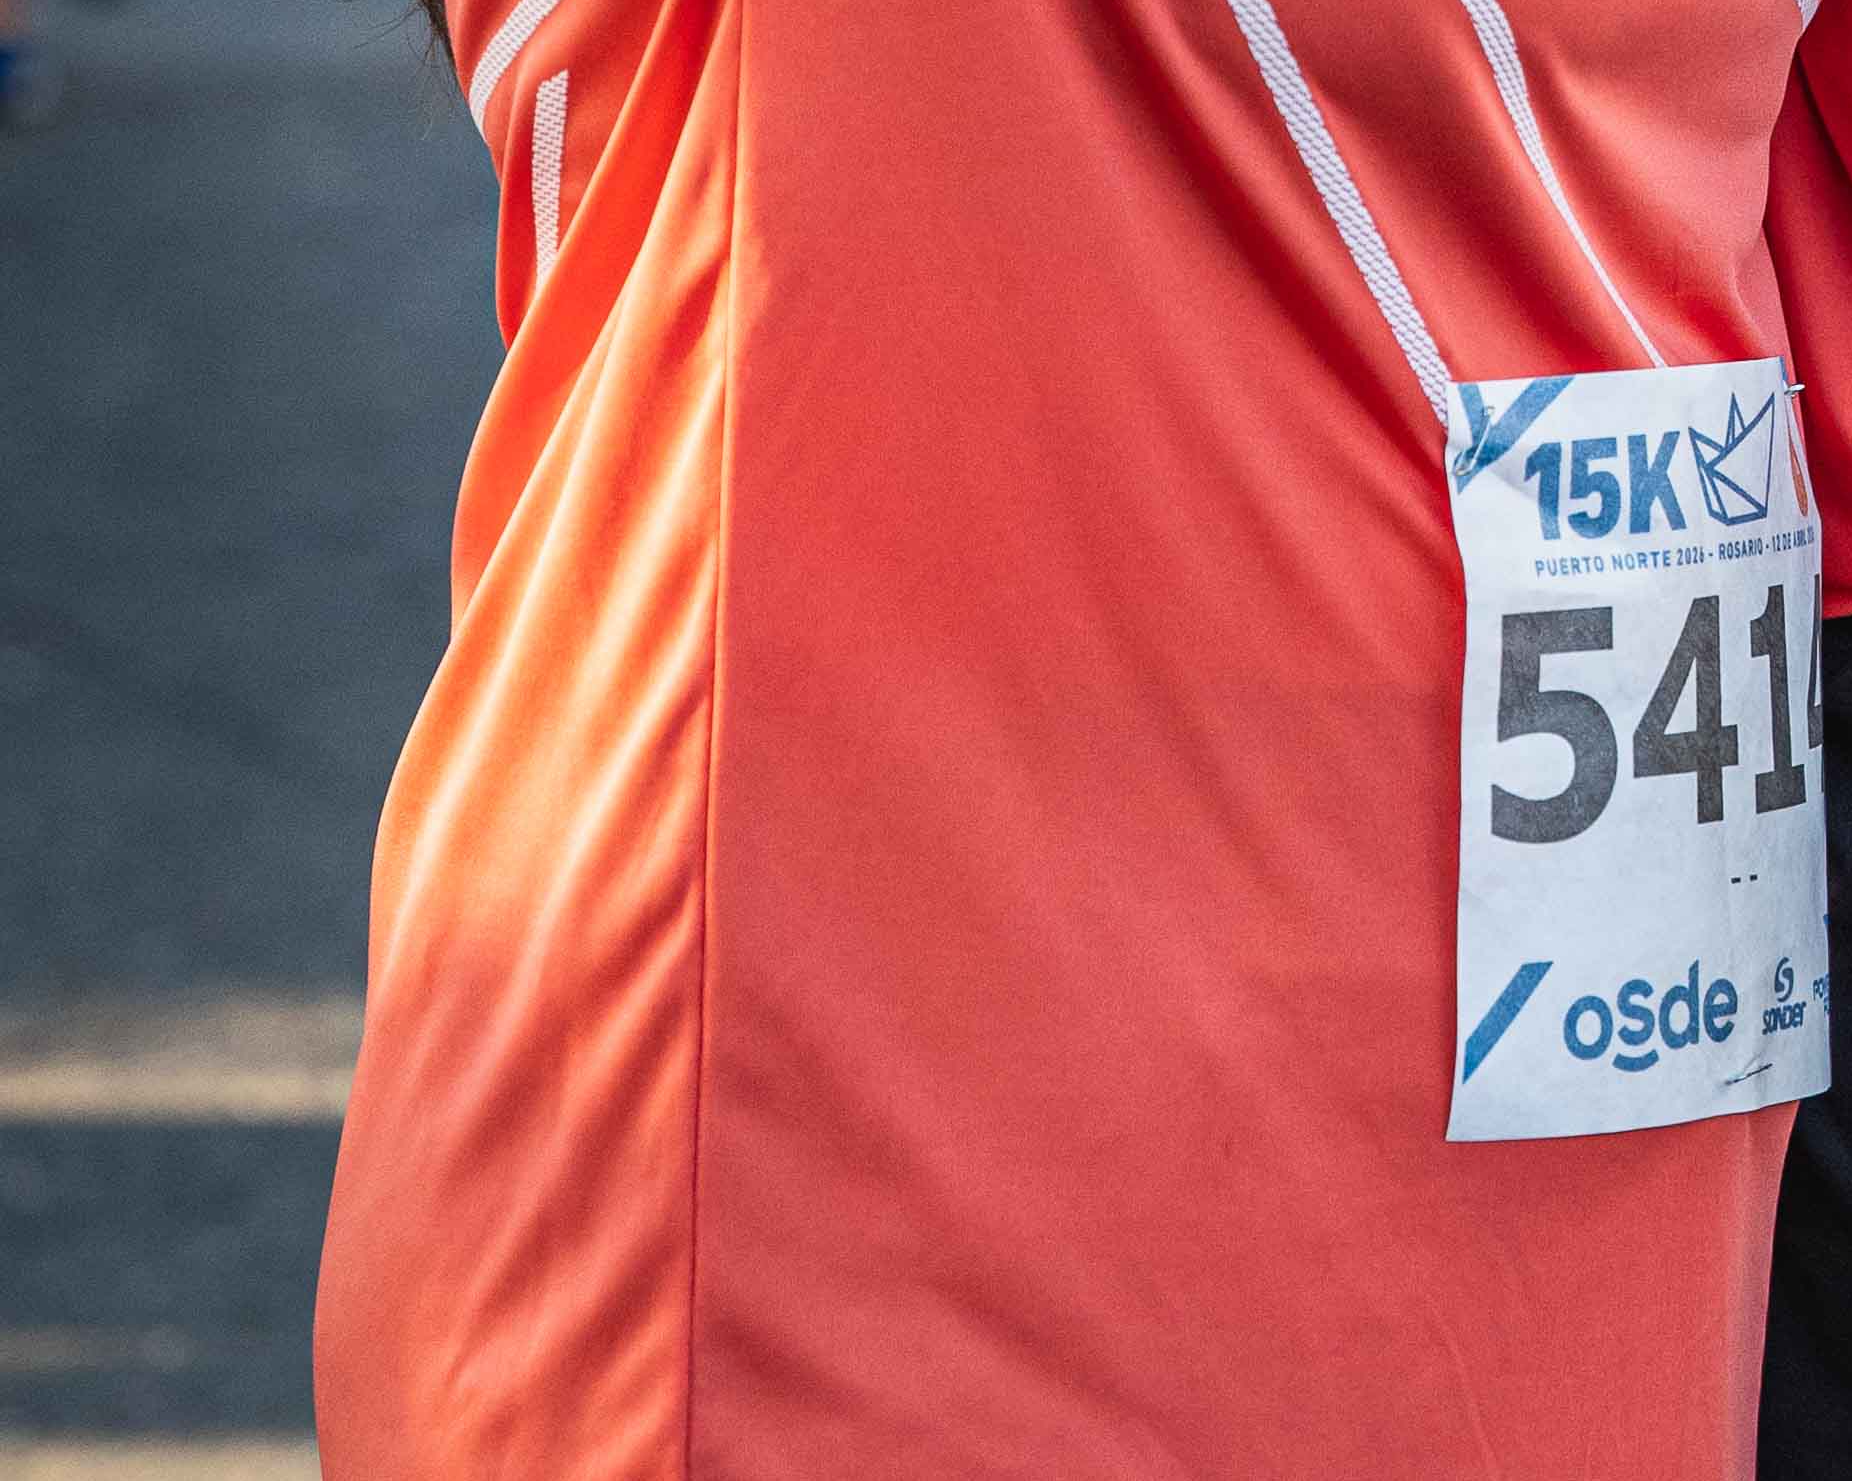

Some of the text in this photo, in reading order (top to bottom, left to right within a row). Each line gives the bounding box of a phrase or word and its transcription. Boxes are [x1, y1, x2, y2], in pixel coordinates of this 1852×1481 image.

[1524, 431, 1690, 541] 15K
[1535, 555, 1605, 577] PUERTO
[1613, 550, 1671, 570] NORTE
[1676, 546, 1705, 566] 2026
[1718, 537, 1764, 561] ROSARIO
[1772, 532, 1781, 553] 12
[1563, 958, 1739, 1067] osde
